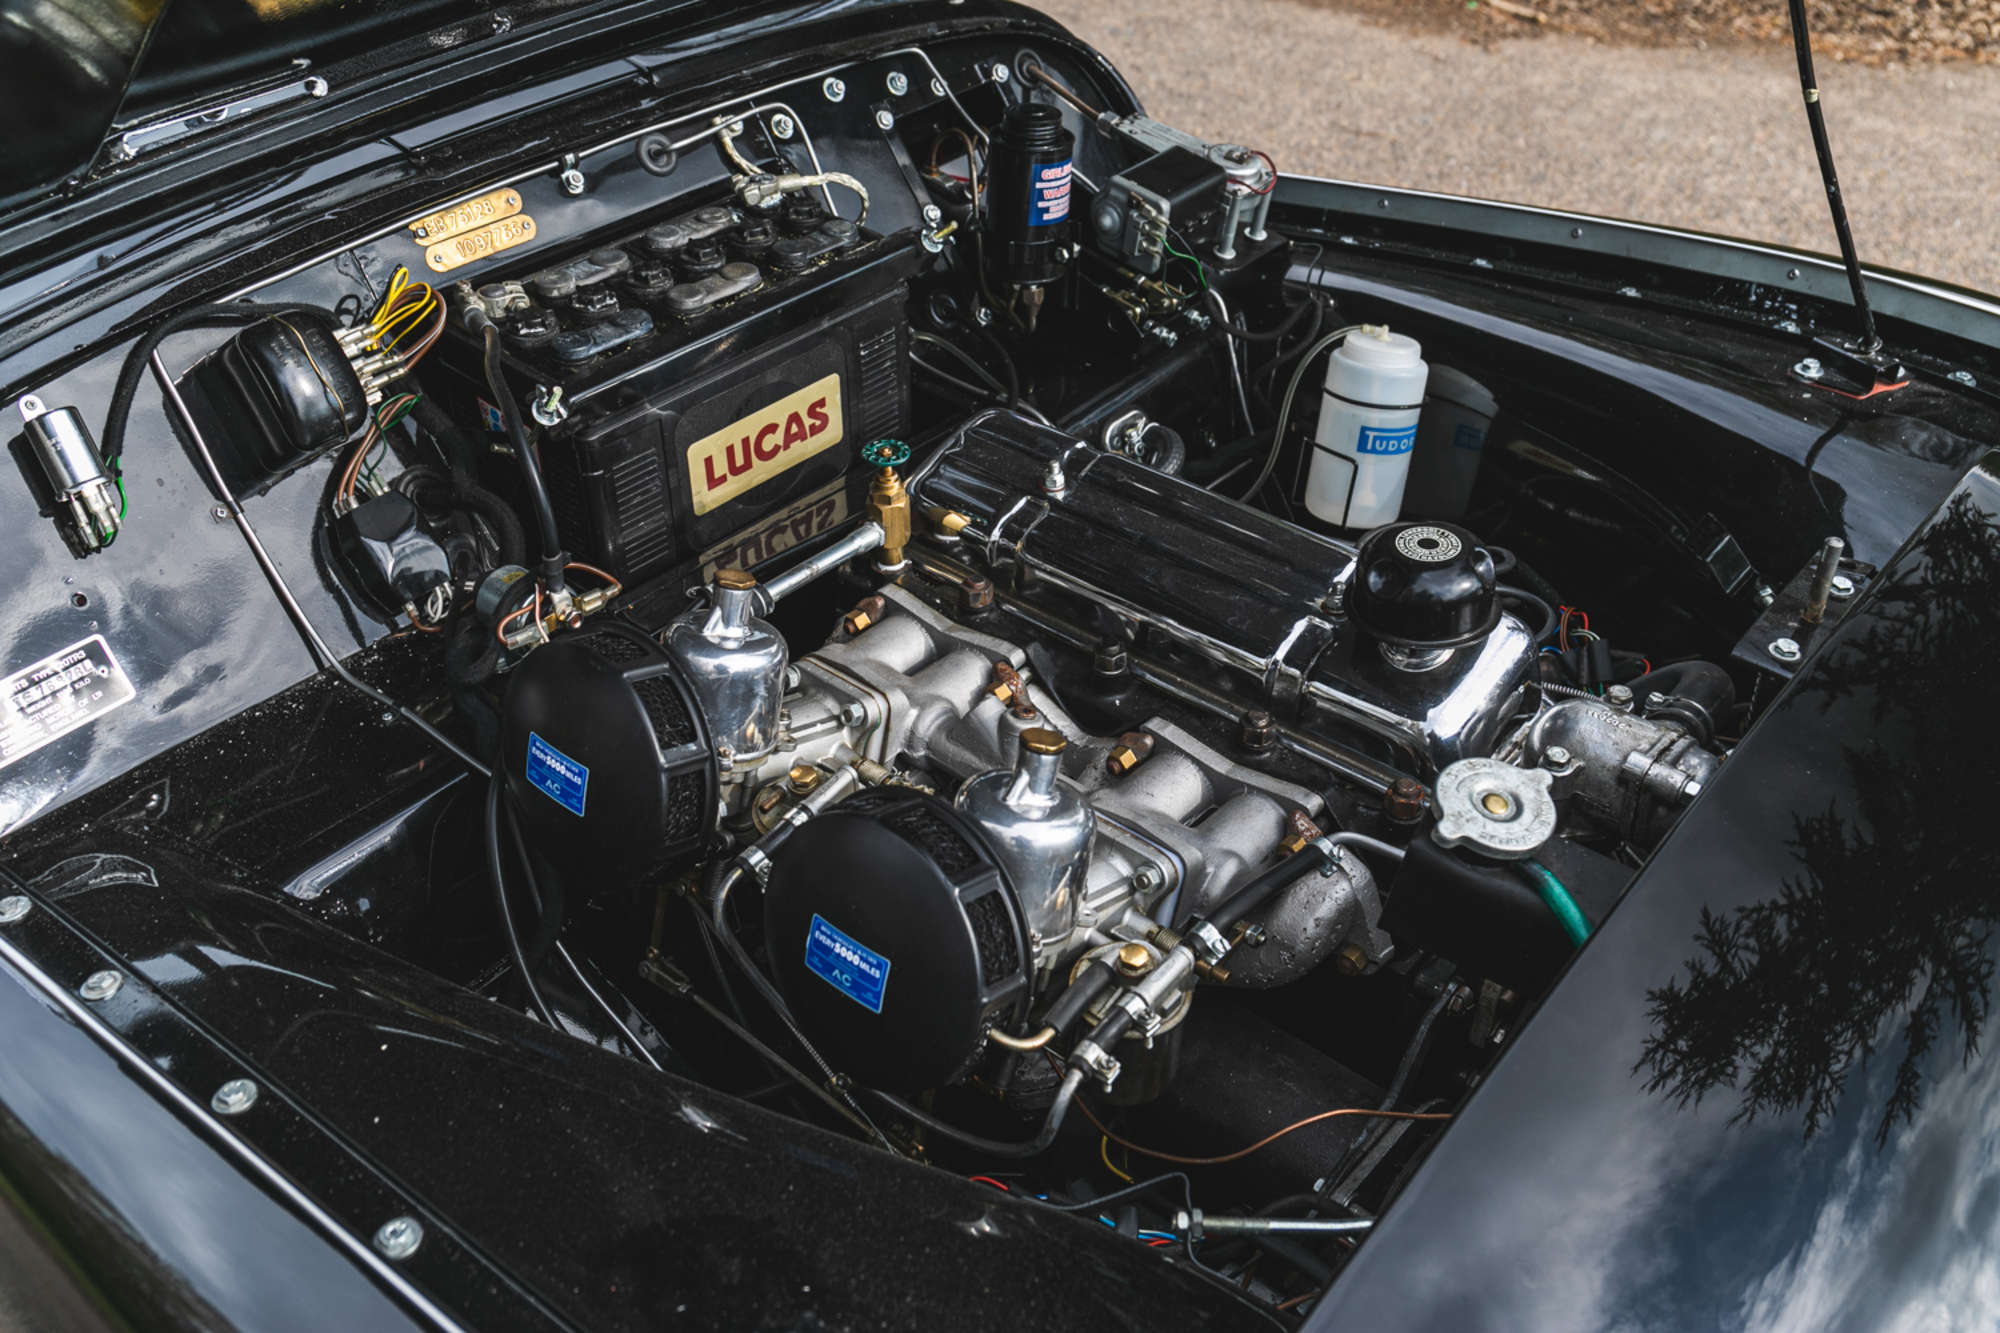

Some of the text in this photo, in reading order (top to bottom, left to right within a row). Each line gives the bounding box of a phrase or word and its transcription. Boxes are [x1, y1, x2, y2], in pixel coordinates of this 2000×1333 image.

[704, 396, 829, 491] LUCAS
[546, 755, 566, 775] 5000
[545, 779, 561, 795] AC
[815, 930, 834, 949] EVERY
[833, 942, 860, 966] 5000
[859, 960, 881, 979] MILES
[832, 969, 852, 987] AC
